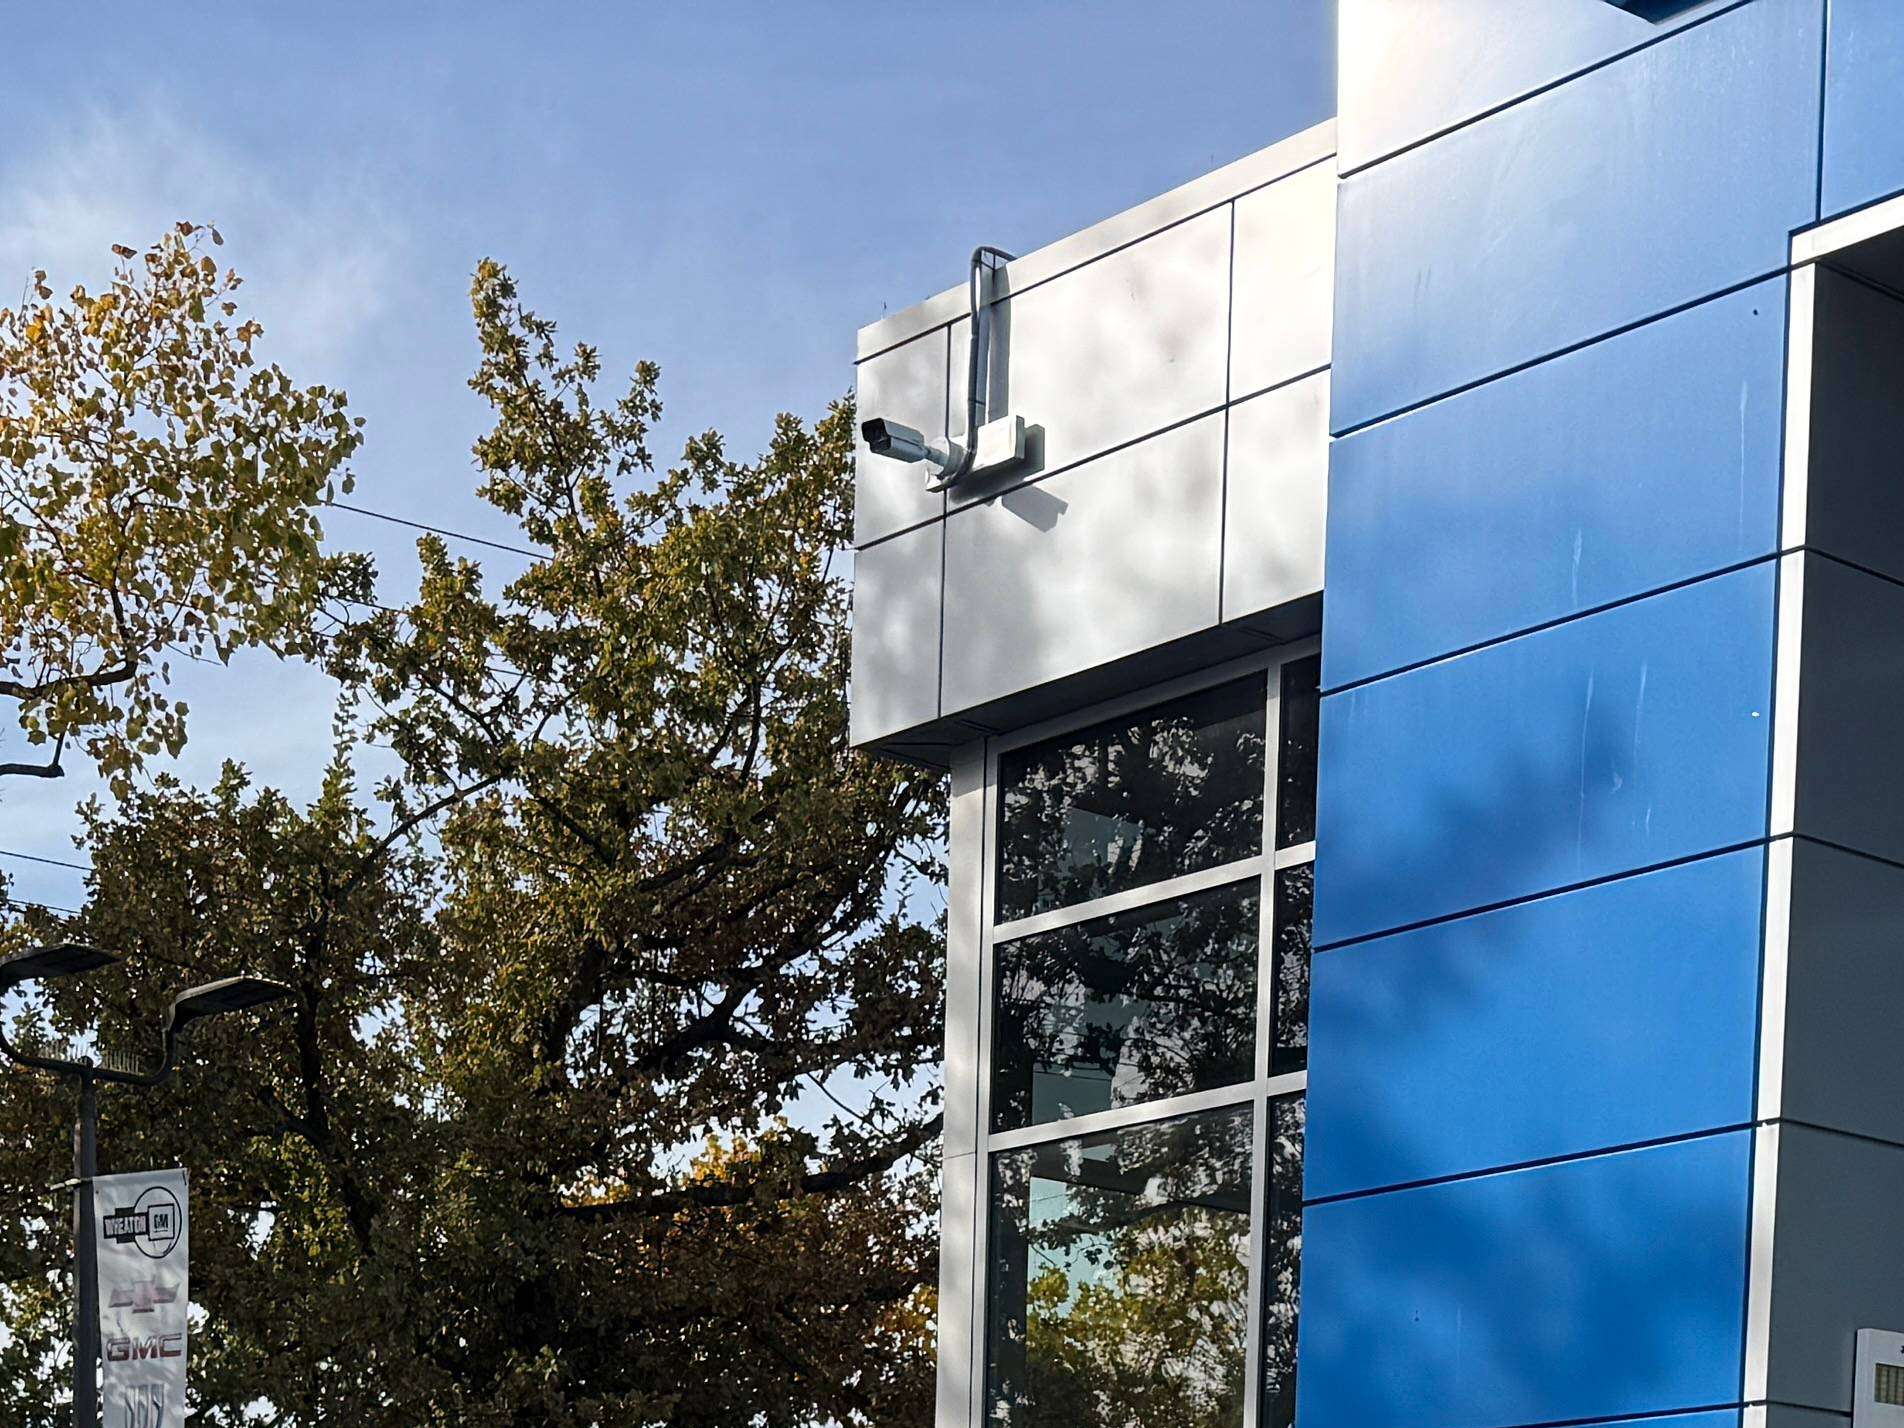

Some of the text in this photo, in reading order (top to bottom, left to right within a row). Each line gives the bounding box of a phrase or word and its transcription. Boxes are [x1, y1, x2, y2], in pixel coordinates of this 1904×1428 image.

[105, 1213, 169, 1238] WHEATON GM
[106, 1332, 182, 1362] GMC
